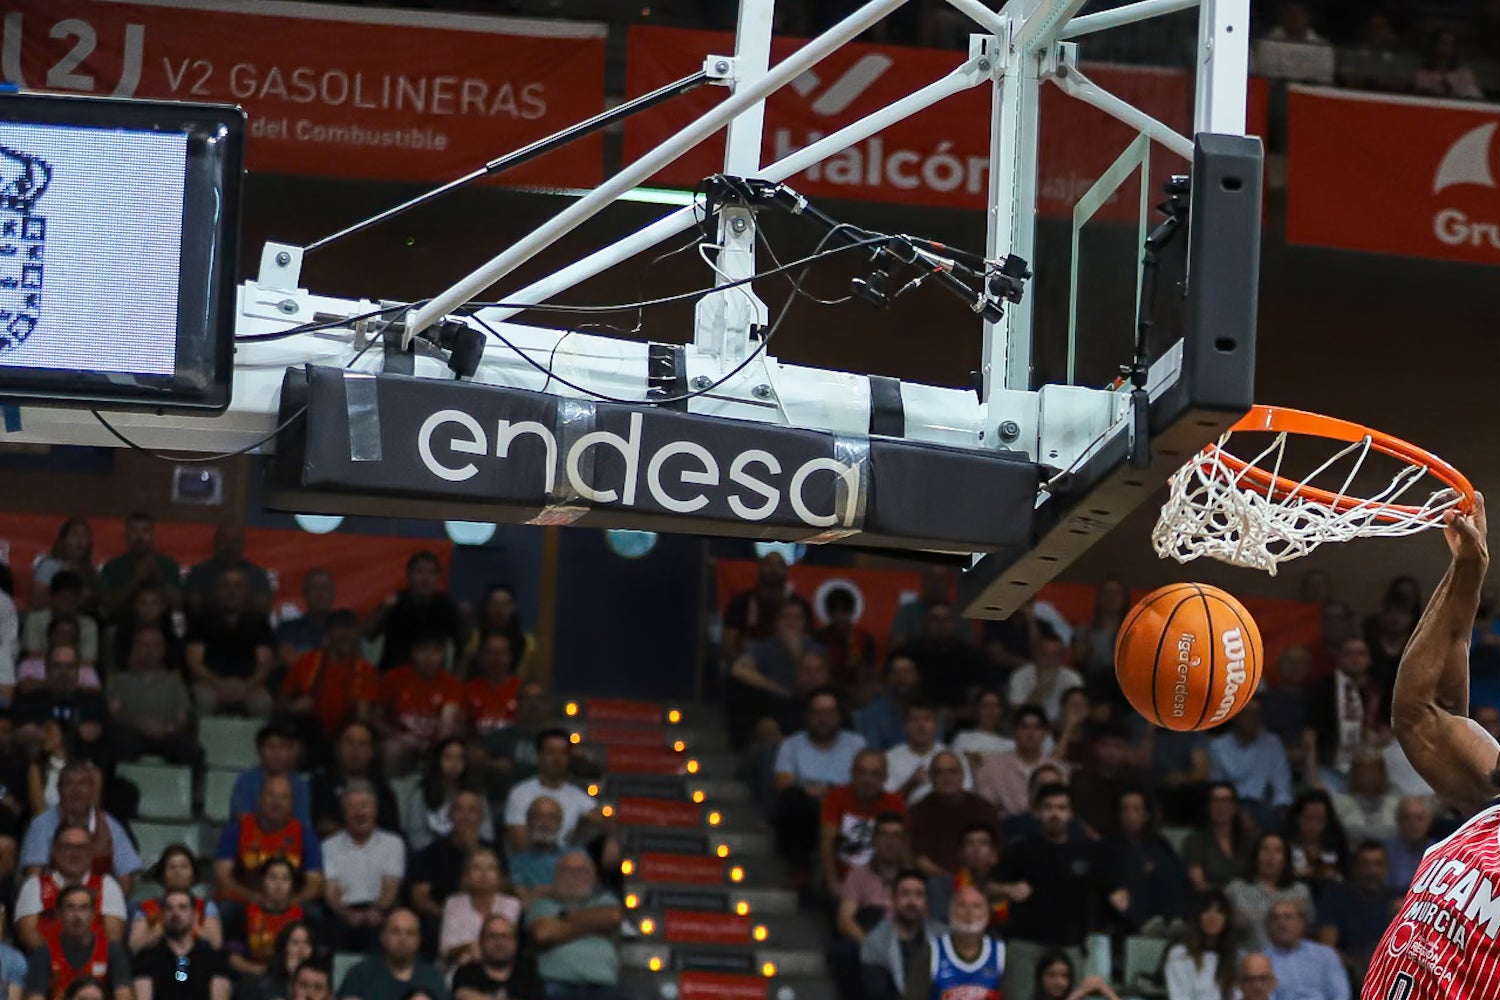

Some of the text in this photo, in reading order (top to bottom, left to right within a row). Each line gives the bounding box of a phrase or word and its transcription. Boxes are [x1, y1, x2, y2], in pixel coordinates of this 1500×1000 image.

[163, 57, 548, 119] V2 GASOLINERAS
[300, 119, 448, 151] Combustible
[417, 409, 860, 527] endesa
[1173, 664, 1189, 717] endesa
[1210, 627, 1248, 722] Wilson
[1404, 900, 1467, 951] MURCIA
